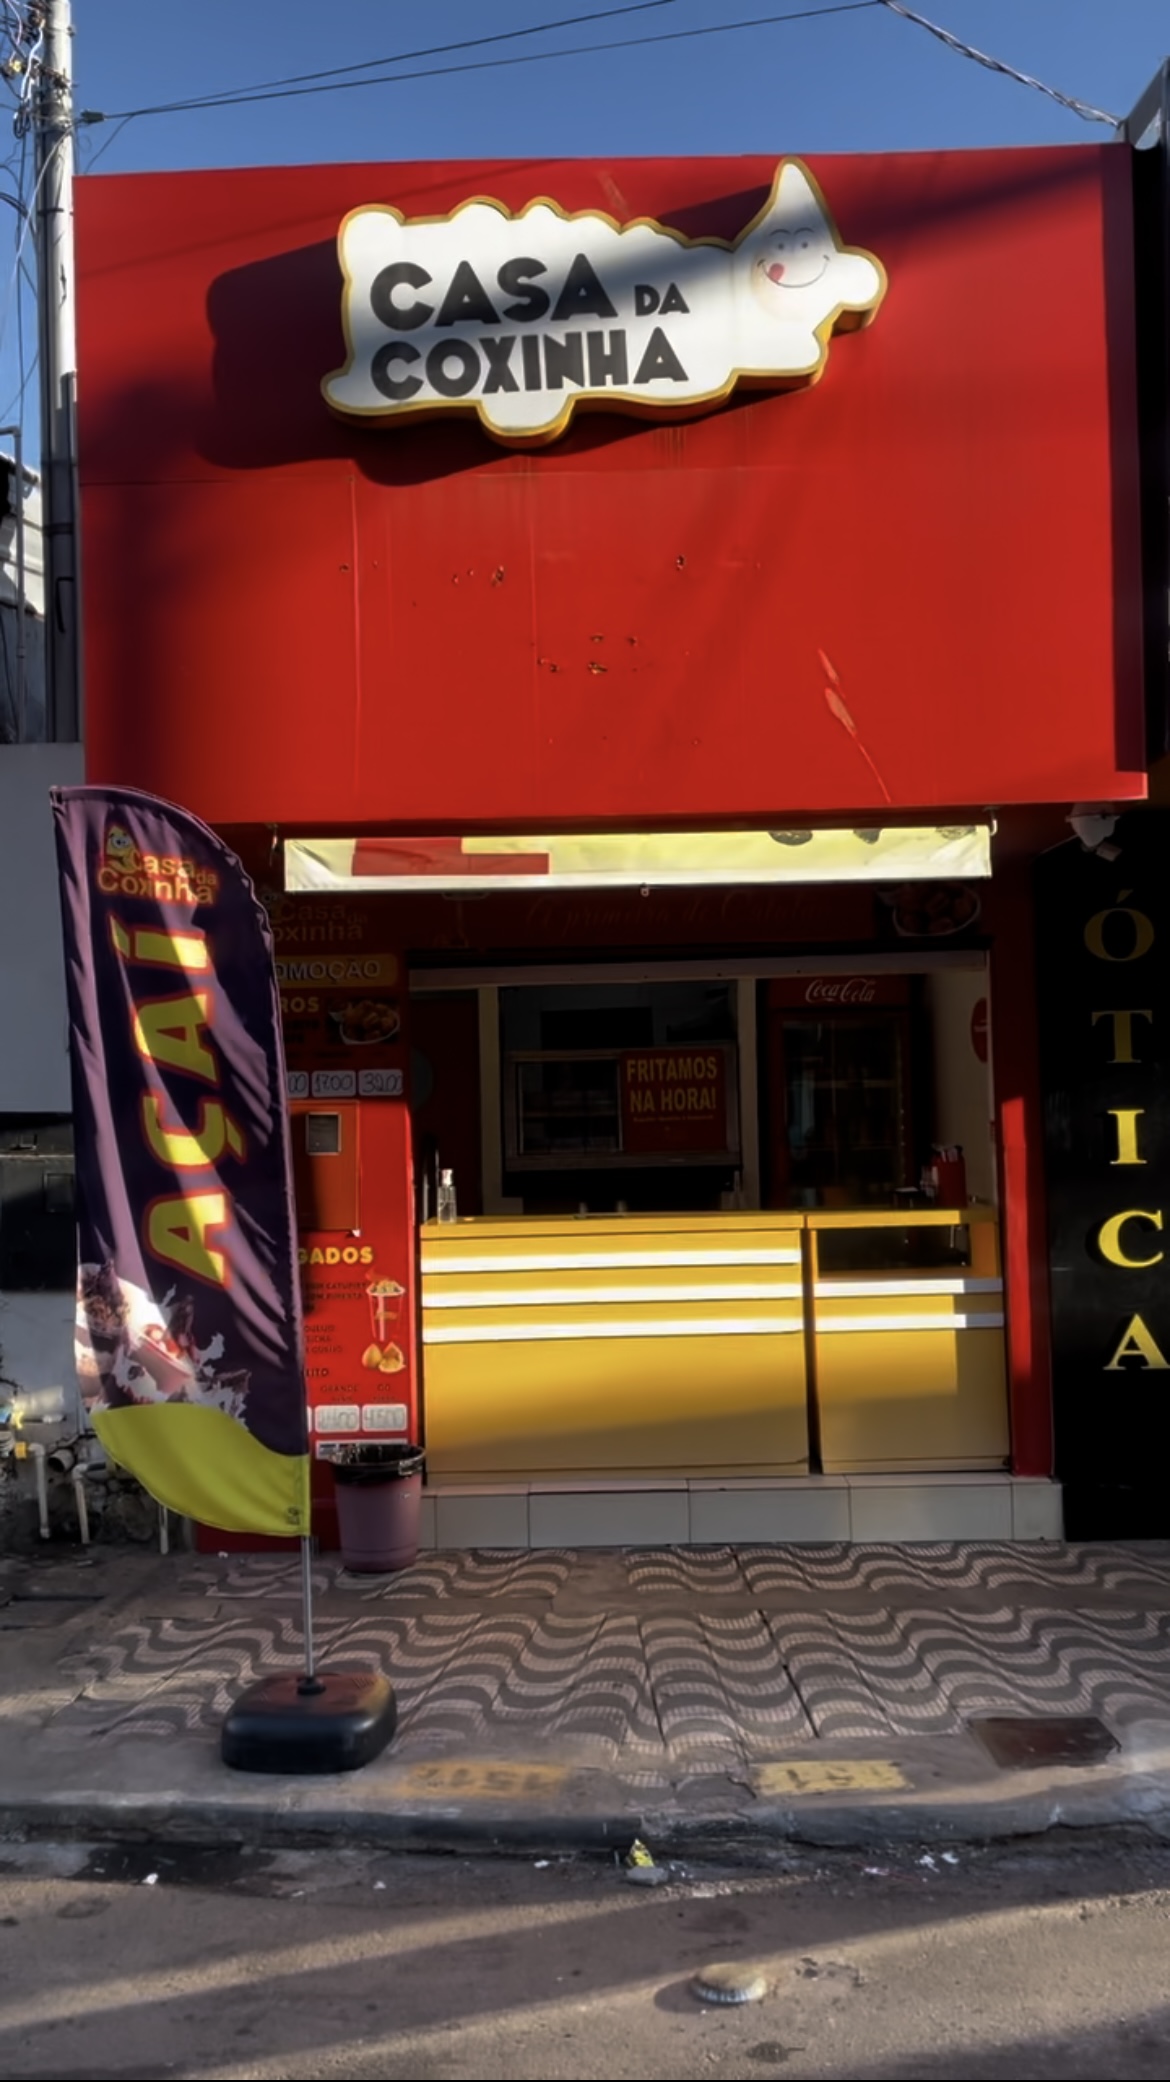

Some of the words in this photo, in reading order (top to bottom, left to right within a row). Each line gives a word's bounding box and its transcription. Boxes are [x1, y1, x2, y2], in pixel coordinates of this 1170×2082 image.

[370, 253, 618, 331] CASA
[635, 283, 690, 316] DA
[370, 326, 689, 400] COXINHA
[196, 869, 218, 886] da
[281, 899, 345, 922] Casa
[273, 920, 363, 943] oxinha
[275, 957, 382, 984] OMOÇÃO
[804, 978, 877, 1003] Coca-Cola
[279, 995, 320, 1014] ROS
[626, 1056, 717, 1083] FRITAMOS
[109, 912, 245, 1290] AÇAÍ
[630, 1089, 655, 1113] NA
[661, 1086, 716, 1112] HORA!
[1084, 889, 1170, 1371] ÓTICA
[298, 1246, 374, 1265] GADOS
